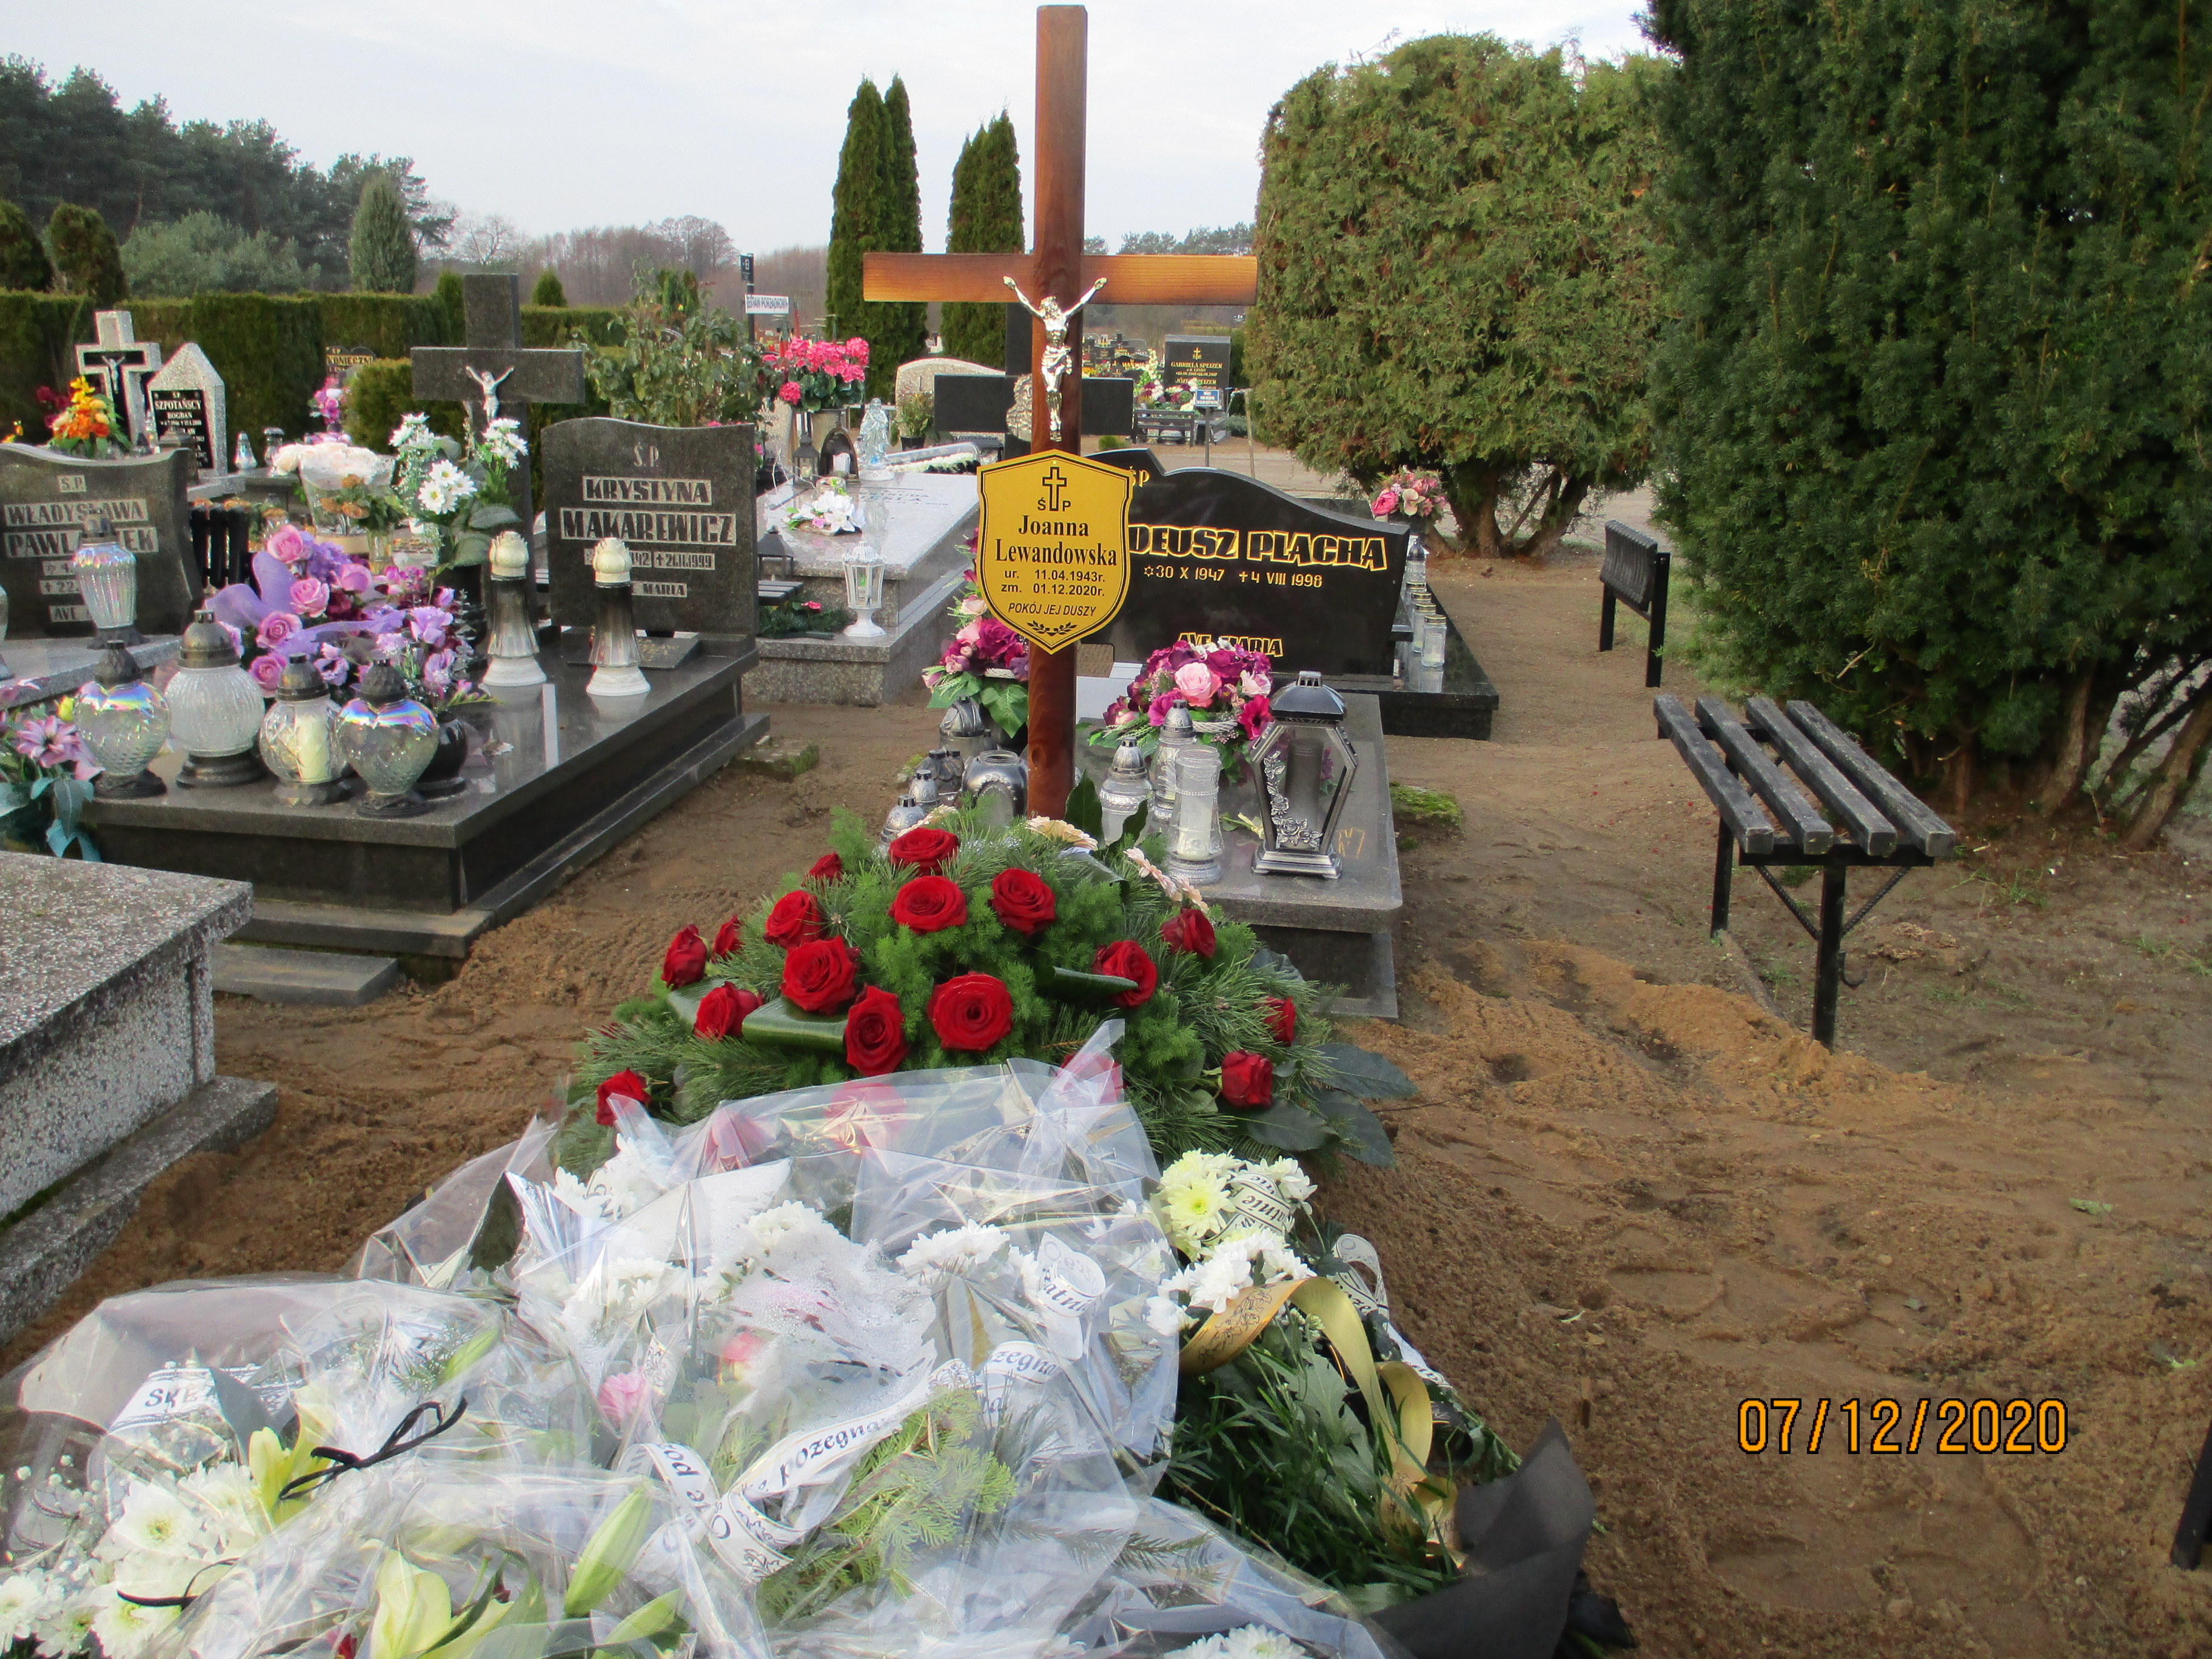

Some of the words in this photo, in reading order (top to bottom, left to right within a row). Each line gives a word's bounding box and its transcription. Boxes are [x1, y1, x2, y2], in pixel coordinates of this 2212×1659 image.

[155, 398, 201, 410] SZPOTAŃSCY
[586, 478, 709, 504] KRYSTYNA
[1037, 497, 1046, 511] Ś
[1062, 500, 1071, 512] P
[563, 510, 733, 543] MAKAREWICZ
[1018, 515, 1089, 537] Joanna
[9, 529, 153, 556] PAWLEK
[995, 538, 1117, 566] Lewandowska
[1128, 524, 1240, 560] DEUSZ
[1247, 529, 1387, 572] PLACHA
[1005, 570, 1019, 578] ur.
[1034, 569, 1105, 582] 11.04.1943r.
[1179, 566, 1189, 580] X
[1195, 567, 1226, 581] 1947
[1251, 571, 1260, 583] 4
[1267, 572, 1286, 586] VIII
[1292, 574, 1324, 588] 1998
[643, 583, 685, 596] MARIA
[1001, 584, 1022, 593] zm.
[1033, 583, 1105, 597] 01.12.2020r.
[1008, 601, 1042, 615] POKÓJ
[1043, 604, 1061, 616] JEJ
[1063, 605, 1096, 617] DUSZY
